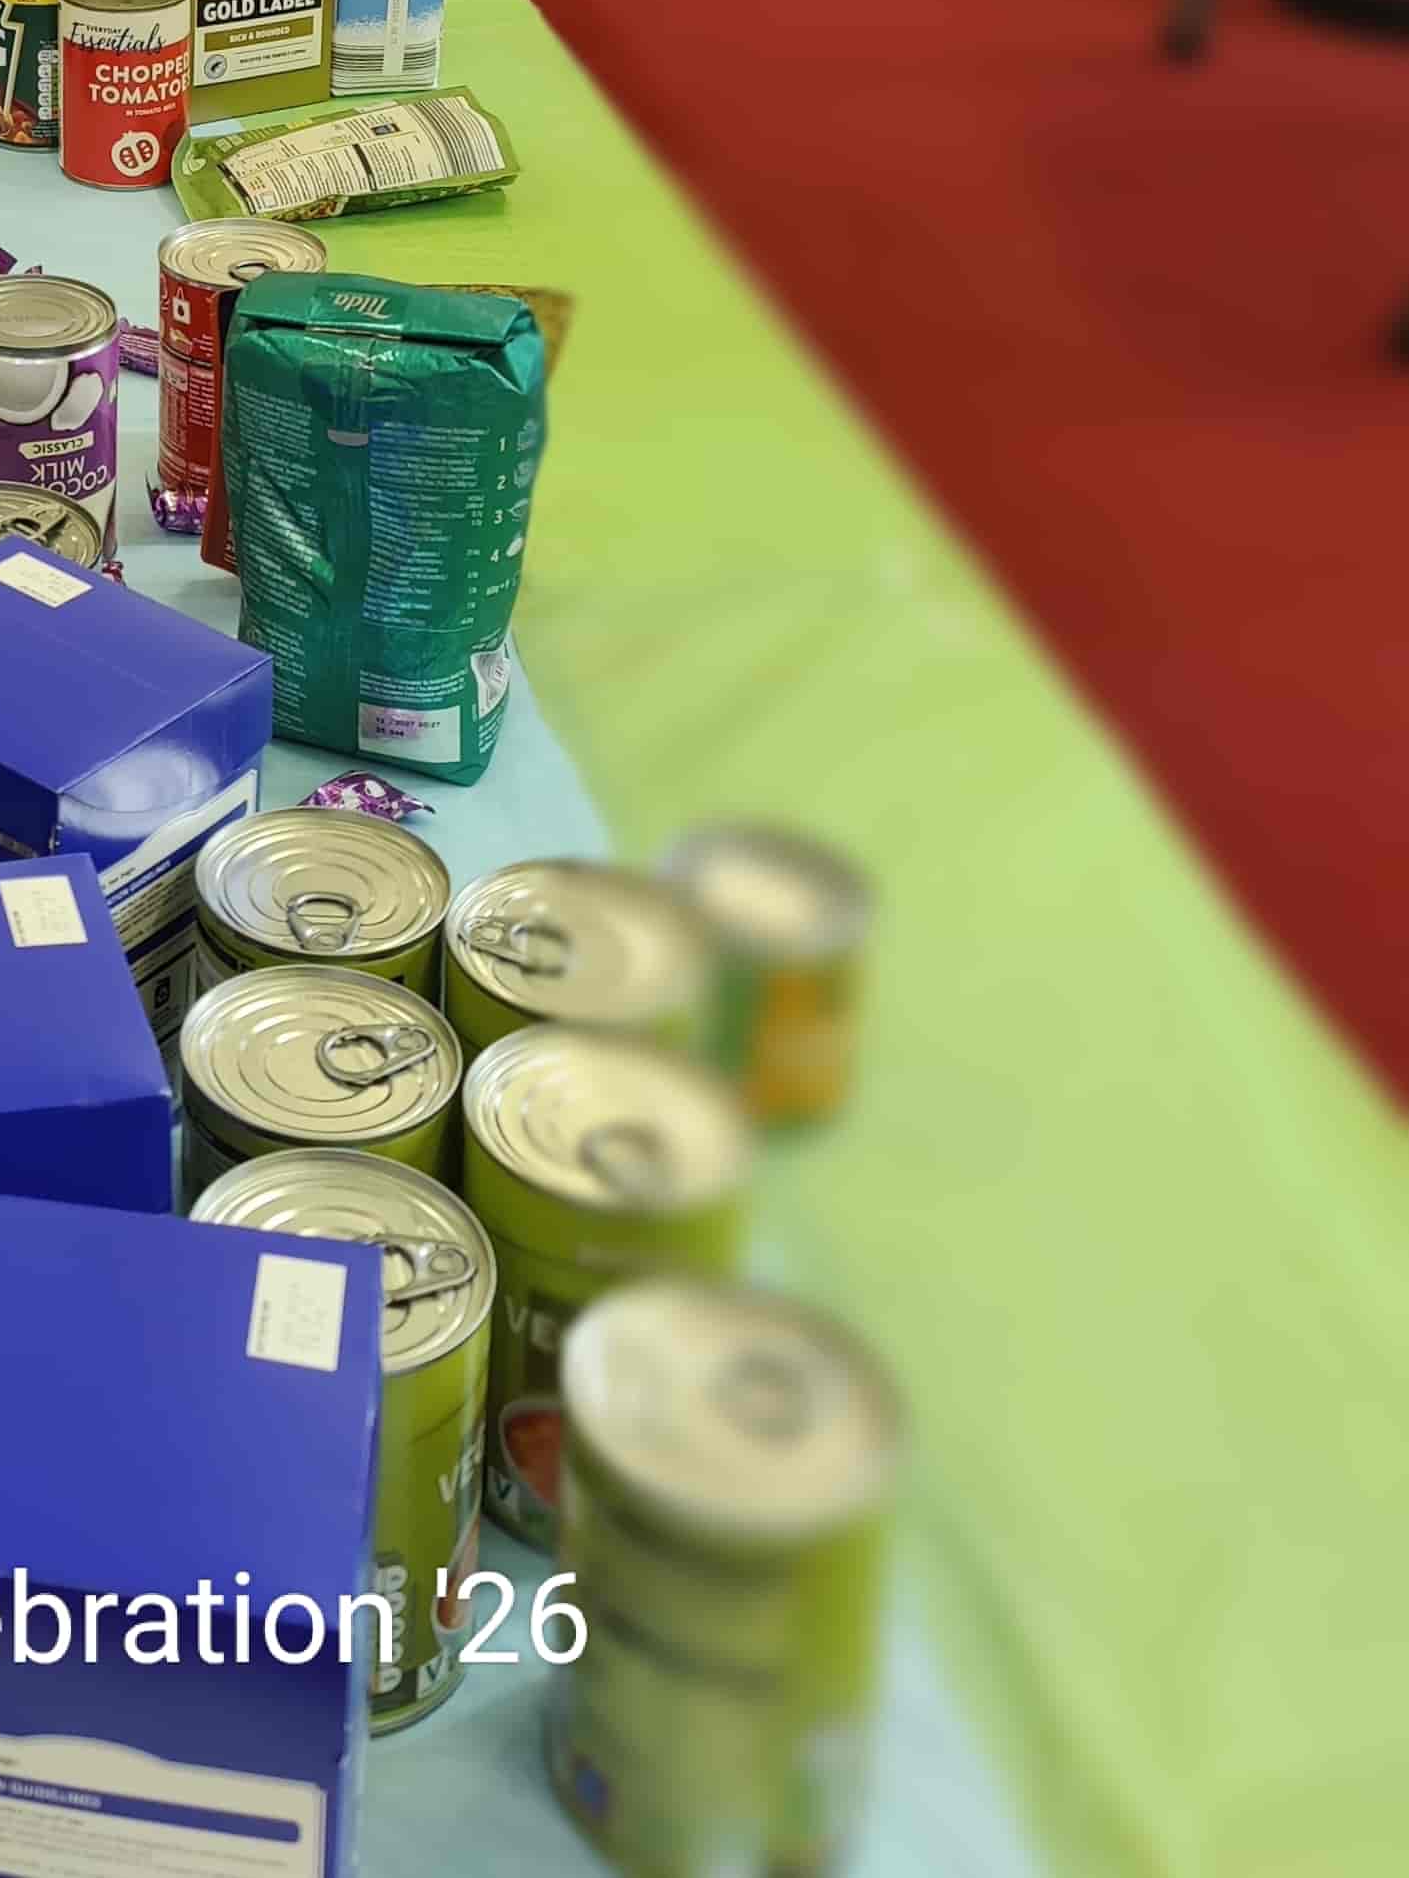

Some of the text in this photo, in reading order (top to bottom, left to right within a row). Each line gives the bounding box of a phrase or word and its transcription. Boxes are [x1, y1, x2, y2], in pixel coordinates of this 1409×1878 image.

[86, 24, 123, 35] EVERYDAY
[229, 31, 247, 44] RICH
[255, 25, 291, 41] ROUNDED
[71, 22, 166, 56] Essentials
[95, 51, 190, 84] CHOPPED
[334, 292, 393, 320] Tilda
[32, 437, 84, 455] CLASSIC
[499, 436, 507, 452] 1
[31, 455, 85, 482] MILK
[44, 464, 108, 497] COCO
[497, 475, 507, 491] 2
[493, 509, 503, 524] 3
[490, 549, 499, 563] 4
